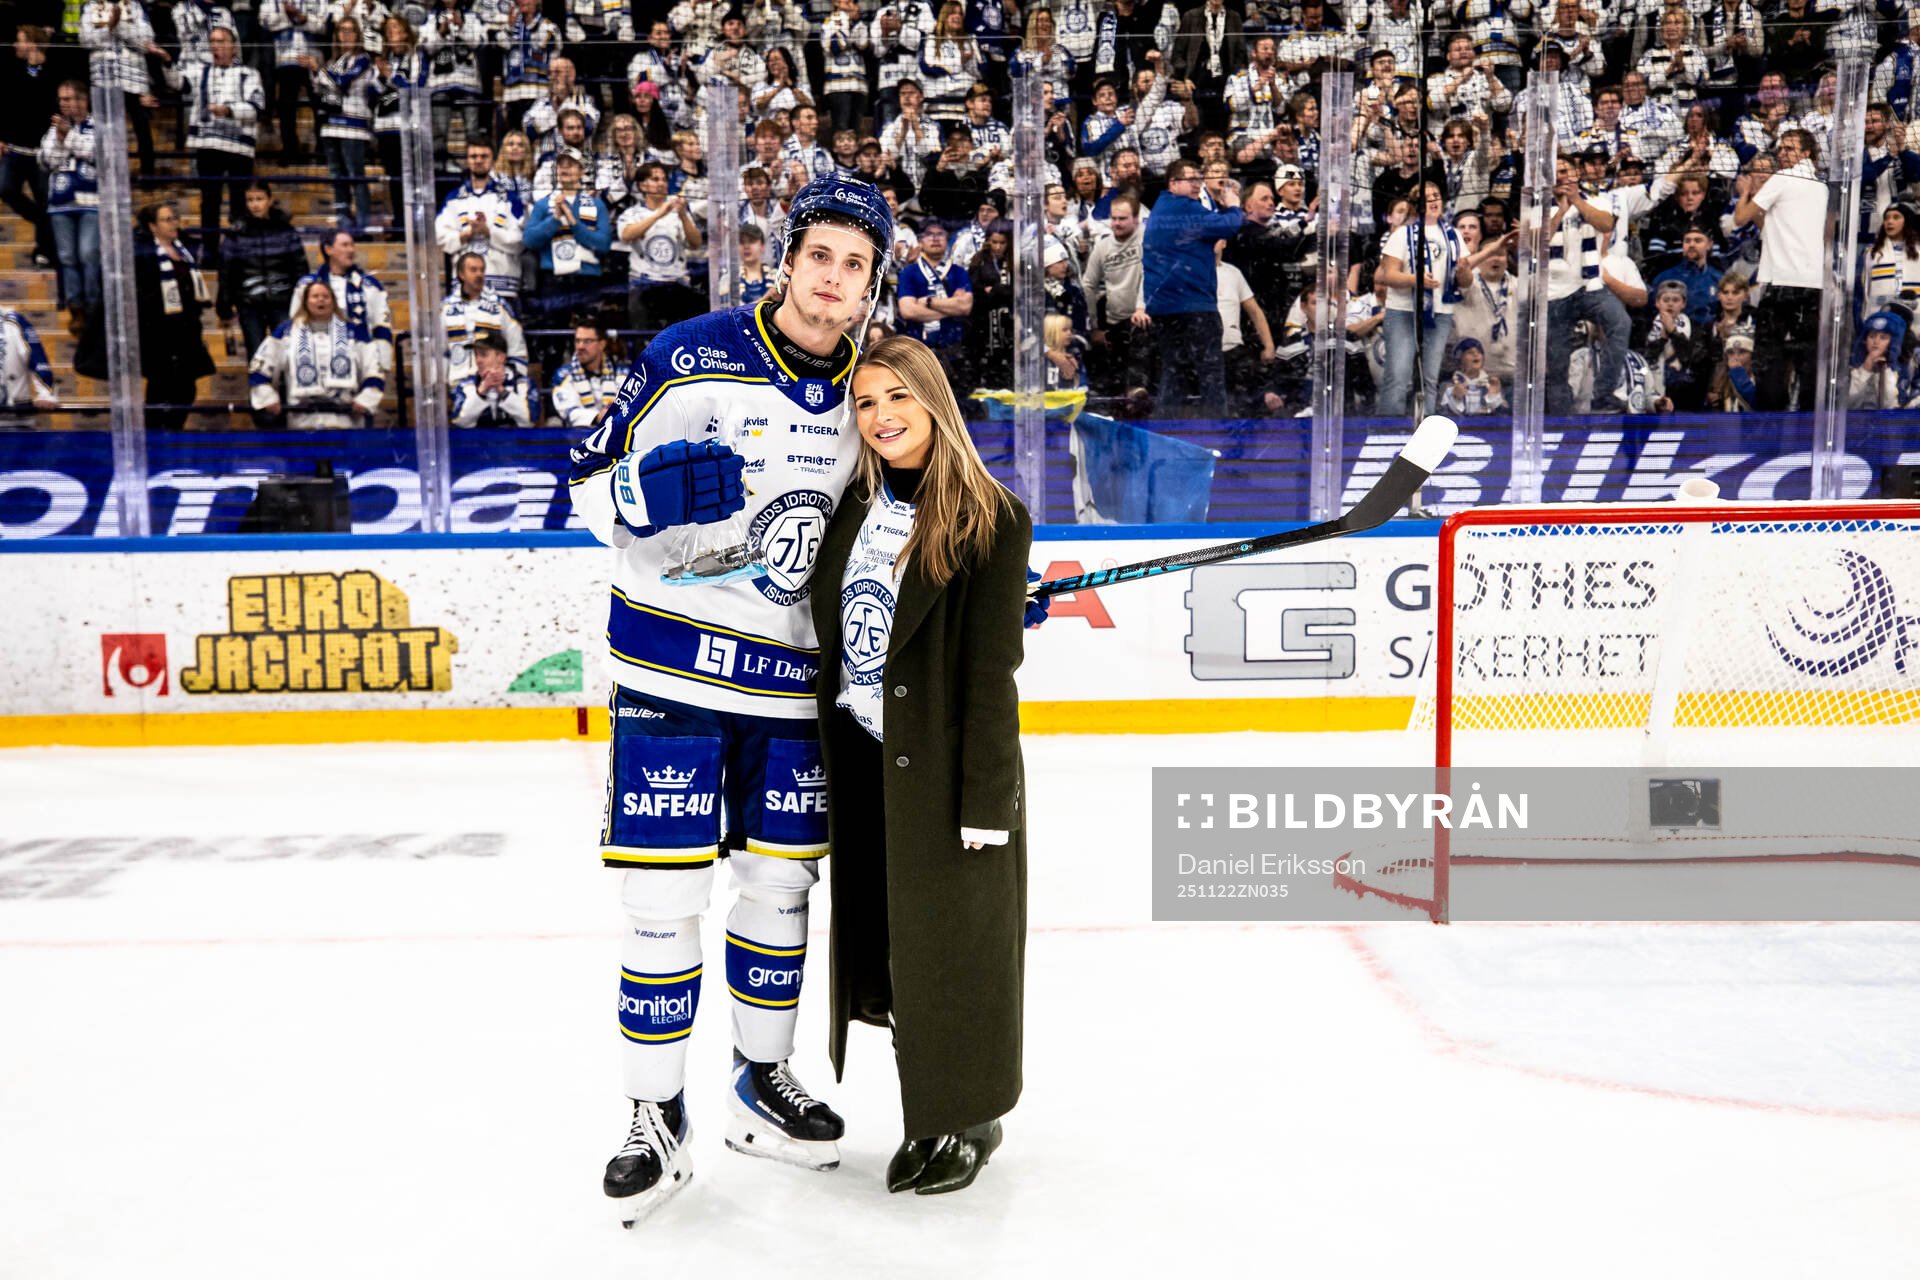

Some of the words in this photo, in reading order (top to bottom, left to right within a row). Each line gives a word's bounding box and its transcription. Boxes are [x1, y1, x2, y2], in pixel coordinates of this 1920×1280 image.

[697, 346, 728, 359] Clas
[700, 358, 745, 372] Ohlson
[805, 390, 824, 405] 50
[800, 424, 839, 436] TEGERA
[800, 466, 827, 475] TRAVEL
[883, 525, 910, 538] TEGERA
[228, 571, 384, 632] EURO
[180, 628, 440, 693] JACKPOT
[742, 653, 771, 675] LF
[617, 706, 666, 720] BAUER
[623, 792, 715, 817] SAFE4U
[639, 929, 677, 940] BAUER
[619, 991, 687, 1018] granitor
[651, 1011, 688, 1025] ELECTRO
